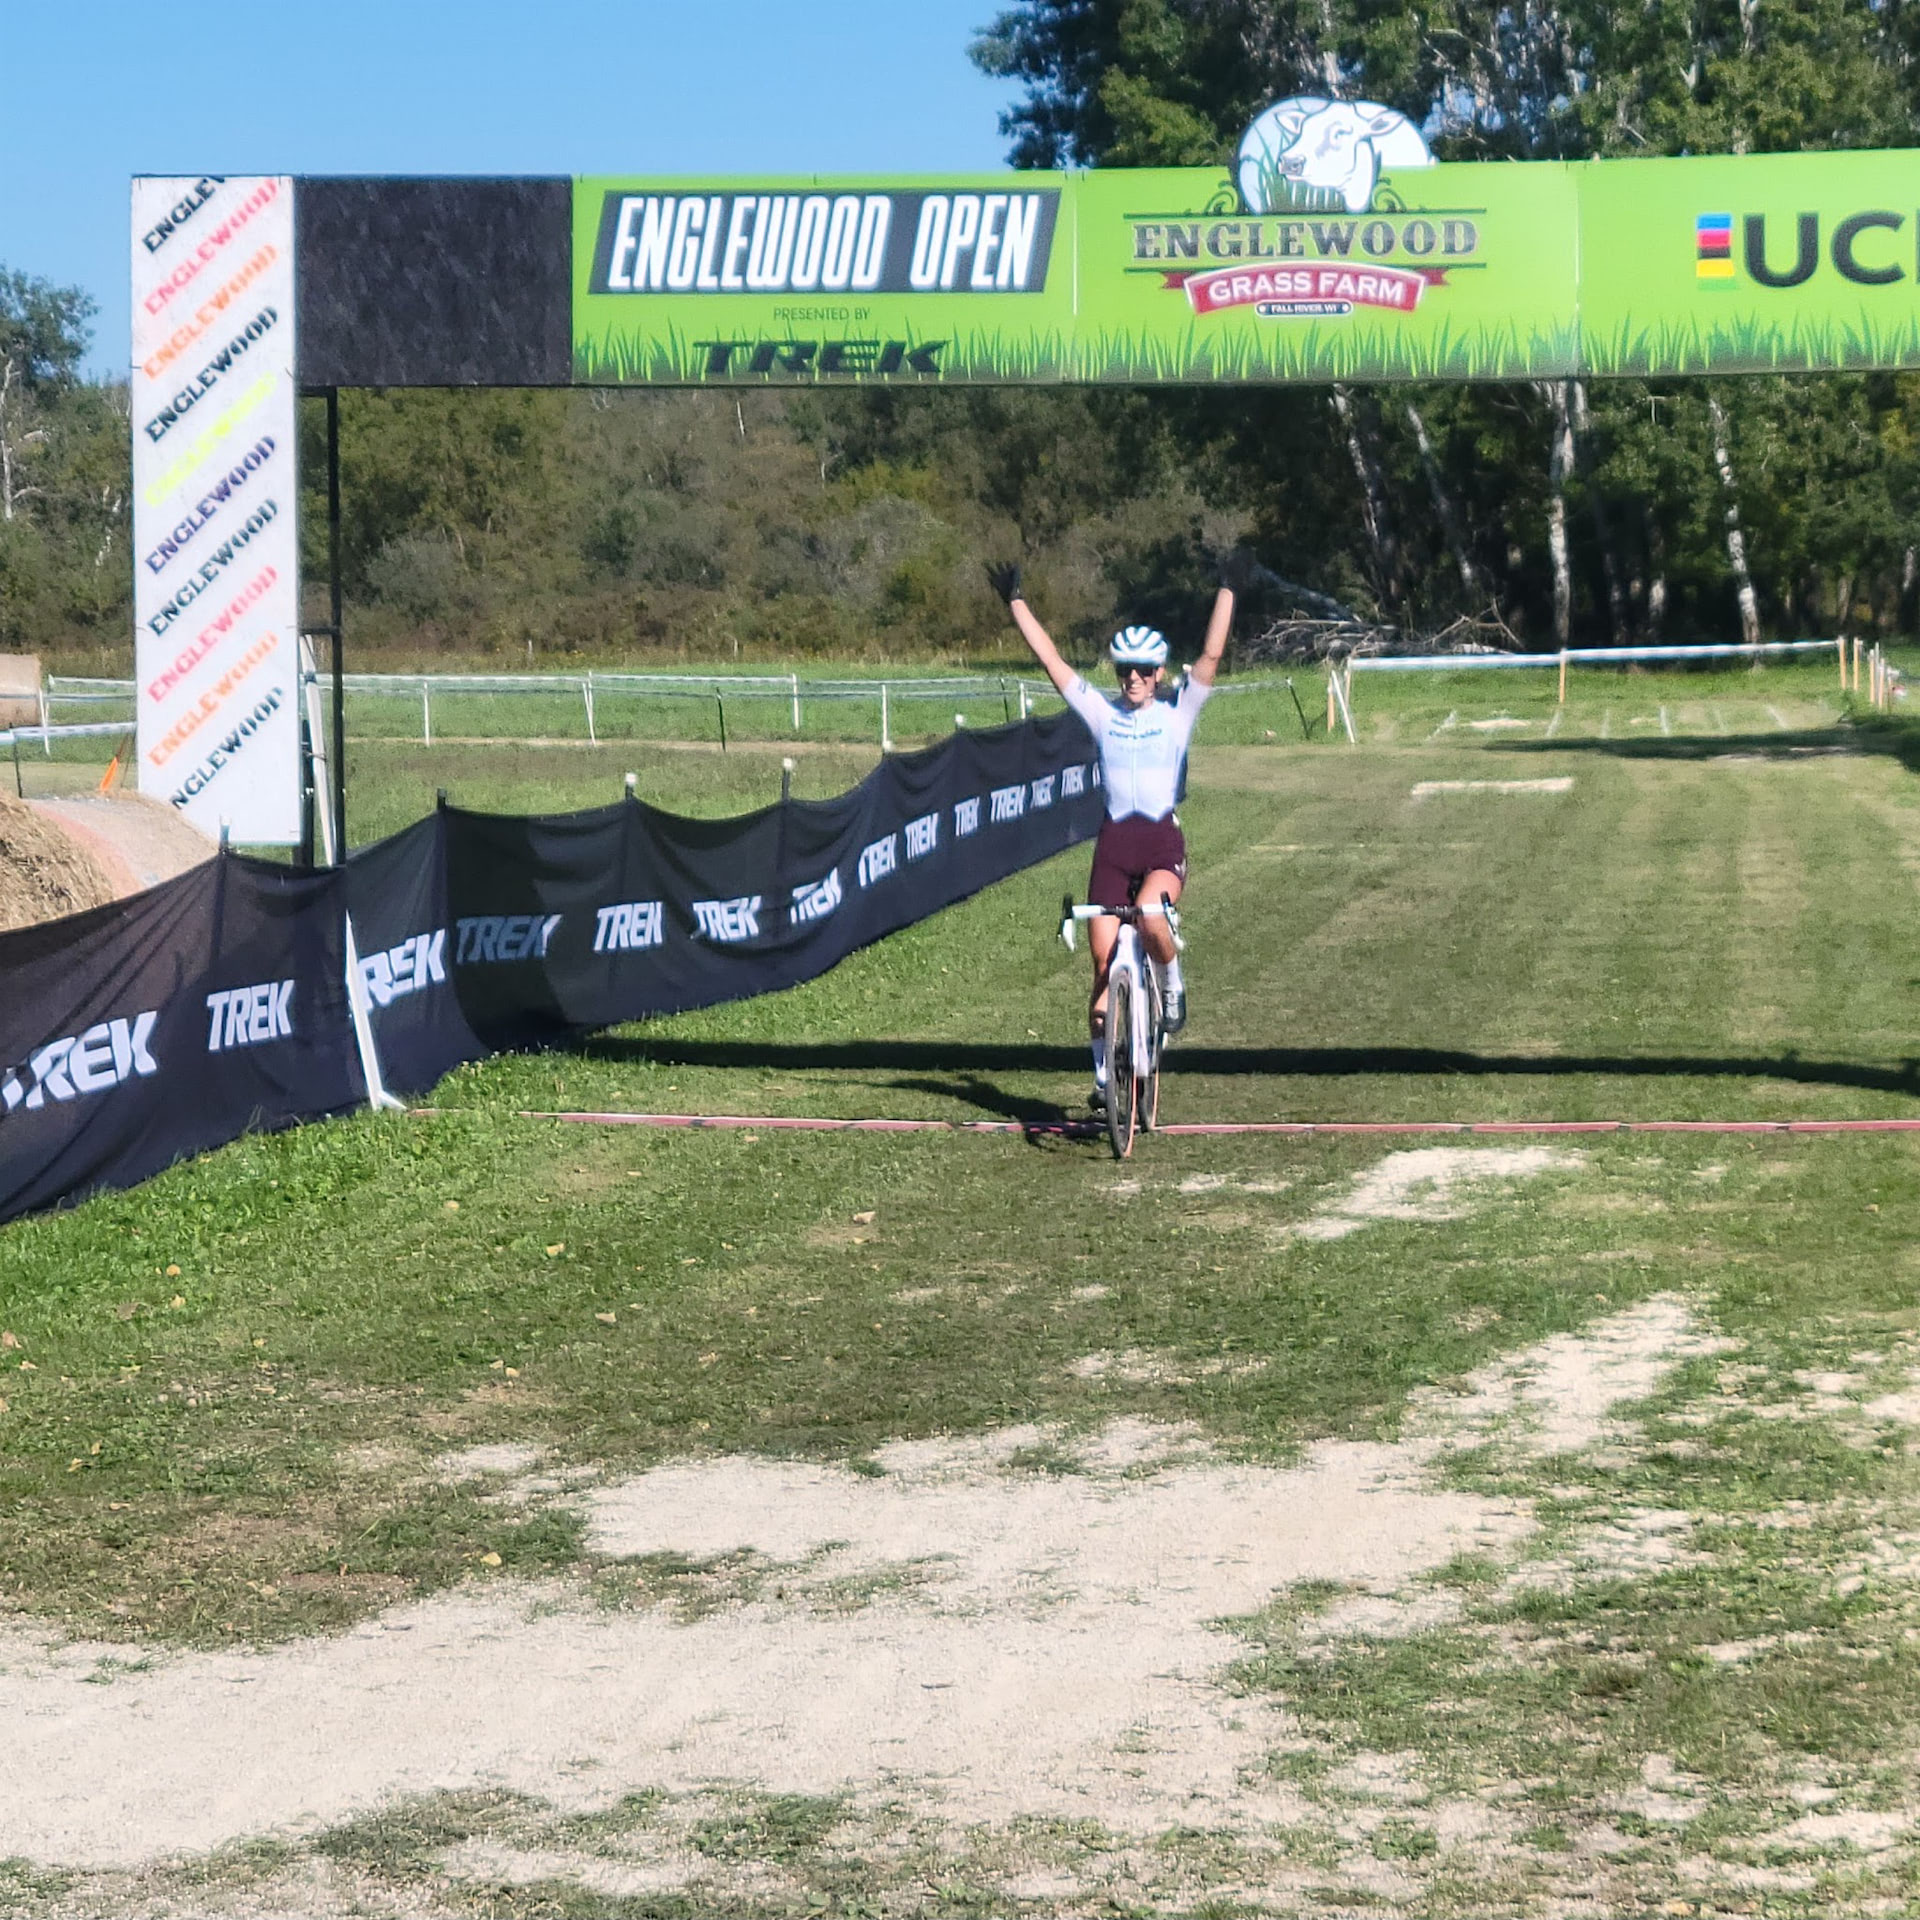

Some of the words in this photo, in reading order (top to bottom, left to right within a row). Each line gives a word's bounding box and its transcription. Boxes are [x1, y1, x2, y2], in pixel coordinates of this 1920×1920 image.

[145, 178, 278, 316] ENGLEWOOD
[609, 196, 890, 290] ENGLEWOOD
[909, 194, 1040, 289] OPEN
[1132, 220, 1478, 260] ENGLEWOOD
[1743, 210, 1920, 287] UC
[143, 244, 278, 380] ENGLEWOOD
[774, 307, 849, 320] PRESENTED
[855, 307, 870, 320] BY
[1208, 271, 1311, 301] GRASS
[1319, 272, 1404, 301] FARM
[1271, 303, 1293, 313] FALL
[144, 306, 278, 443] ENGLEWOOD
[693, 340, 953, 373] TREK
[144, 436, 276, 575] ENGLEWOOD
[147, 498, 278, 637] ENGLEWOOD
[147, 564, 279, 702] ENGLEWOOD
[147, 630, 280, 767] ENGLEWOOD
[170, 687, 284, 810] NGLEWOOD
[905, 813, 938, 860] TREK
[990, 784, 1026, 823] TREK
[858, 833, 897, 887] TREK
[456, 914, 562, 965] TREK
[594, 901, 663, 952] TREK
[692, 895, 761, 942] TREK
[358, 928, 446, 1009] REK
[207, 979, 295, 1051] TREK
